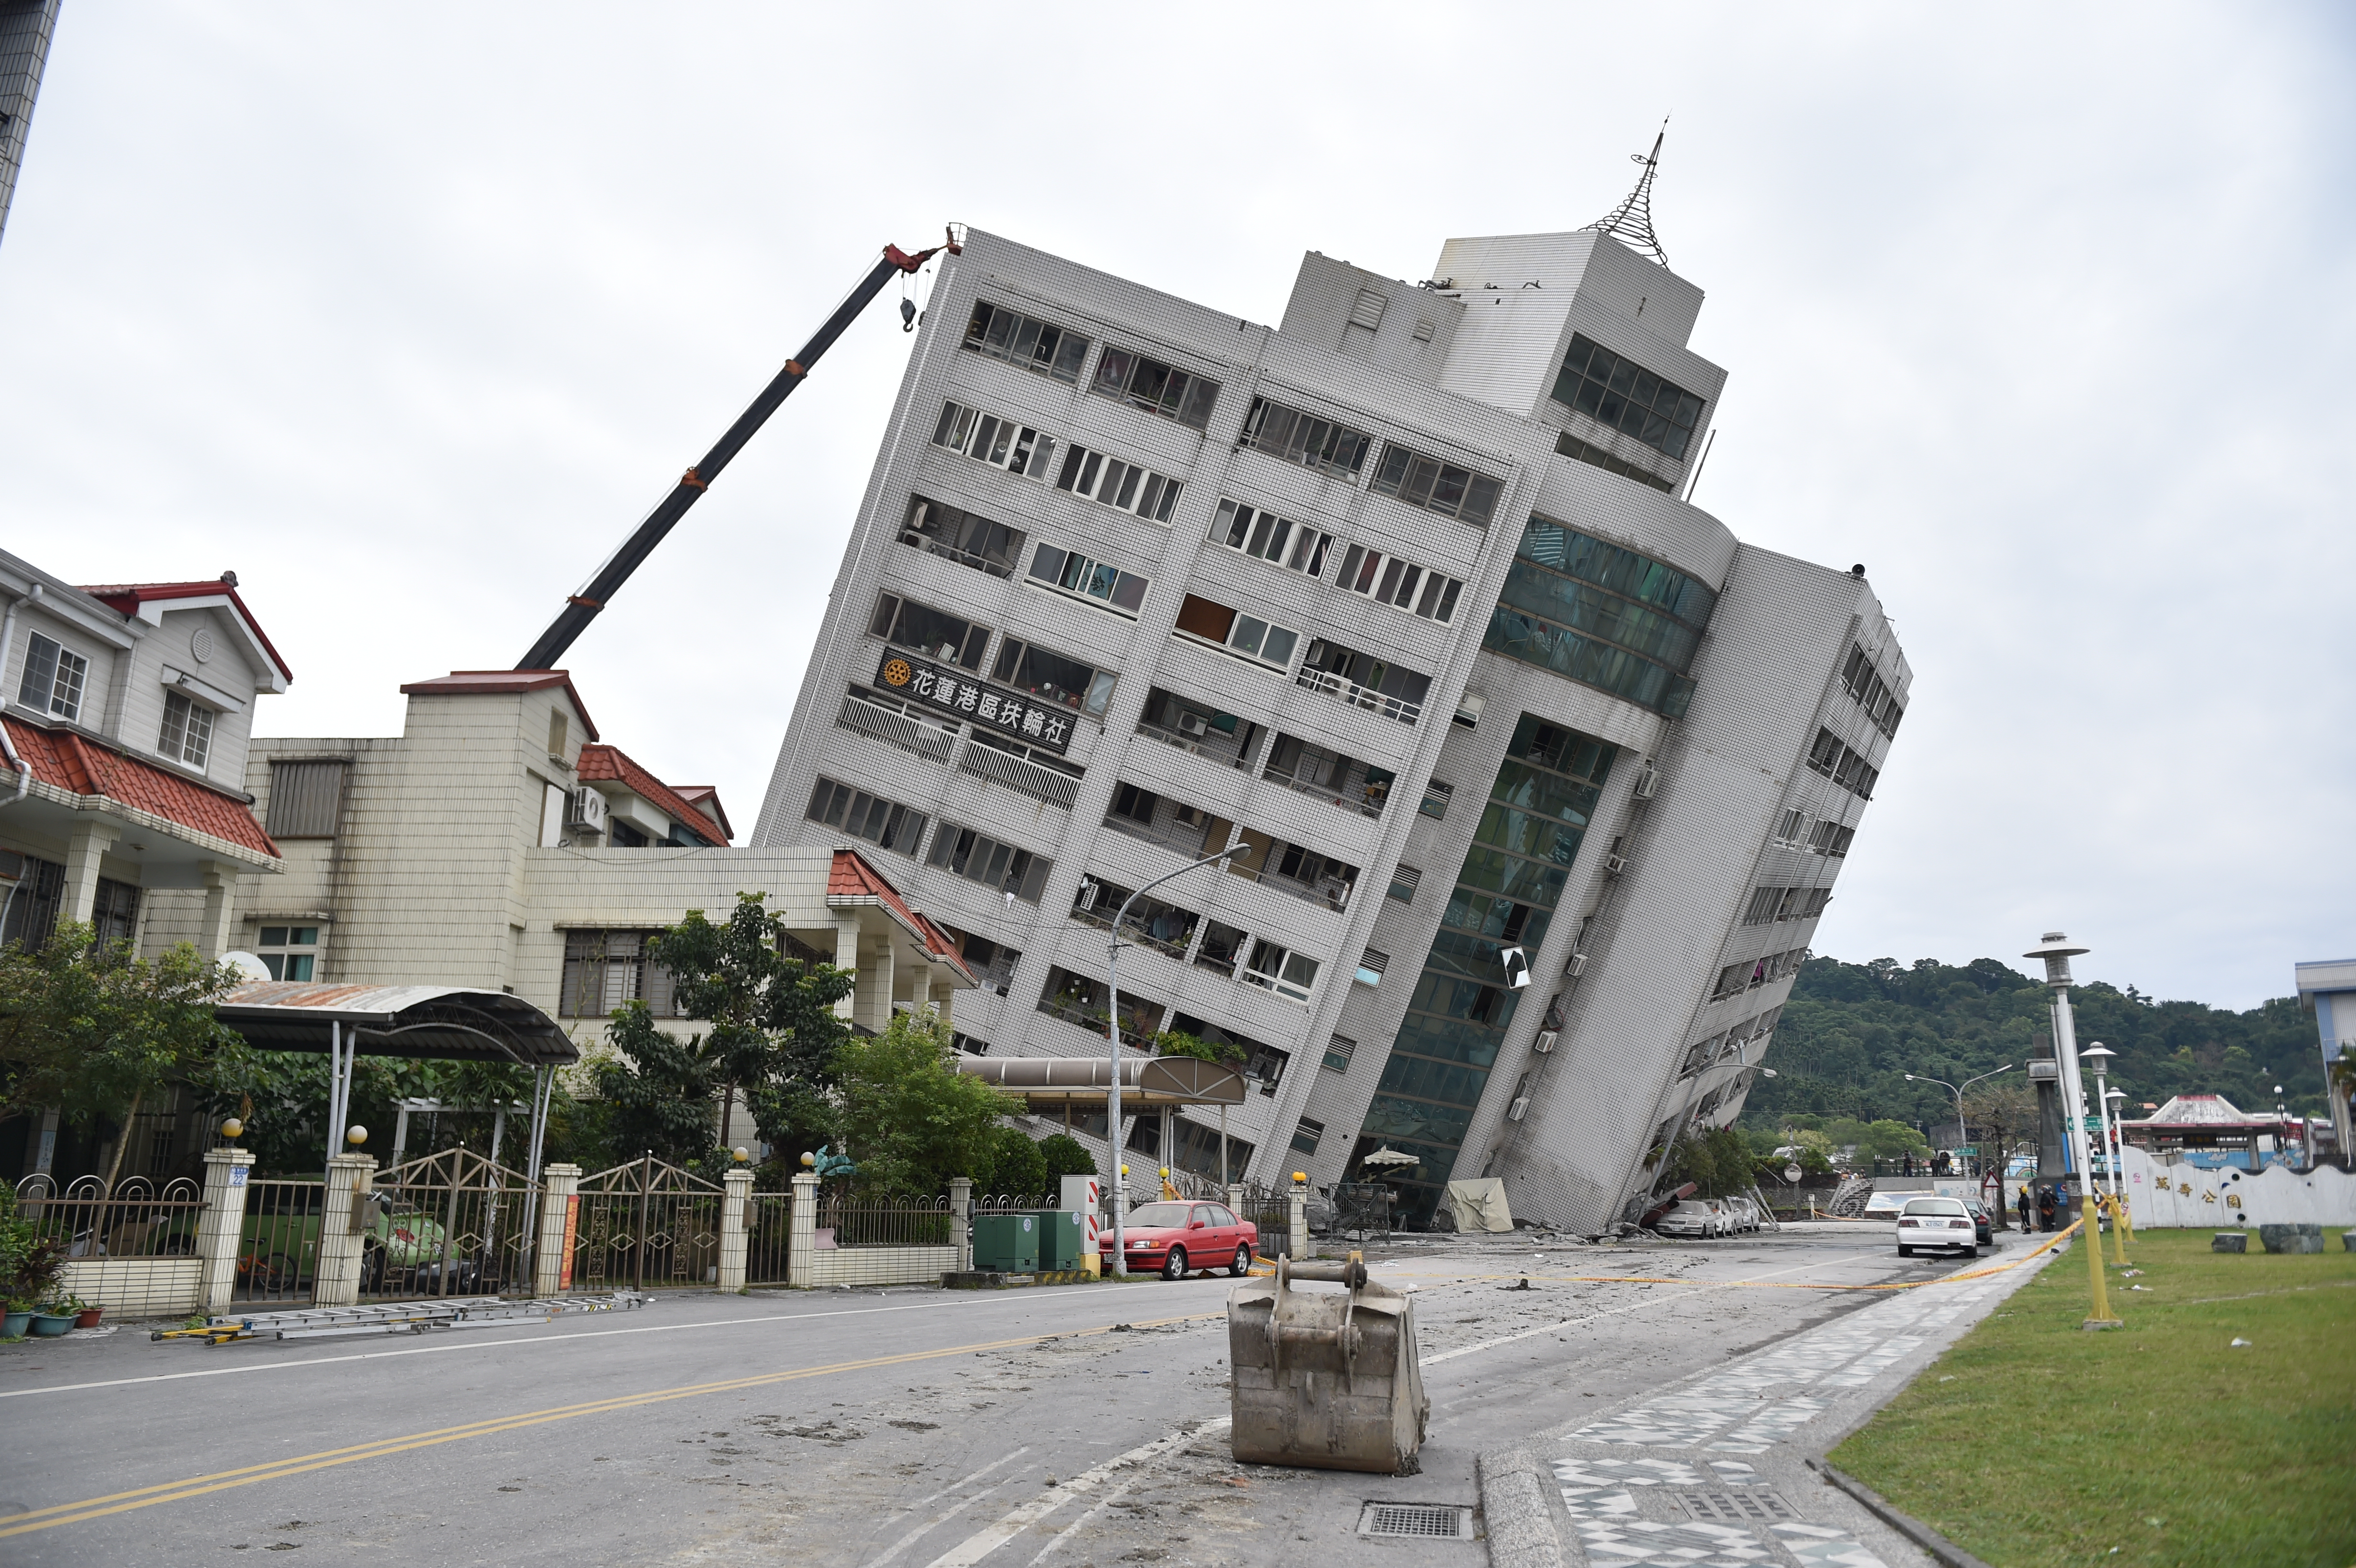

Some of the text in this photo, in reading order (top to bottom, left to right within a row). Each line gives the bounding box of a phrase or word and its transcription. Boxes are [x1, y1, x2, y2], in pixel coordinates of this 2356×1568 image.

[913, 669, 1067, 745] 花蓮港區扶輪社
[233, 1175, 243, 1185] 22
[2155, 1176, 2241, 1209] 萬壽公園
